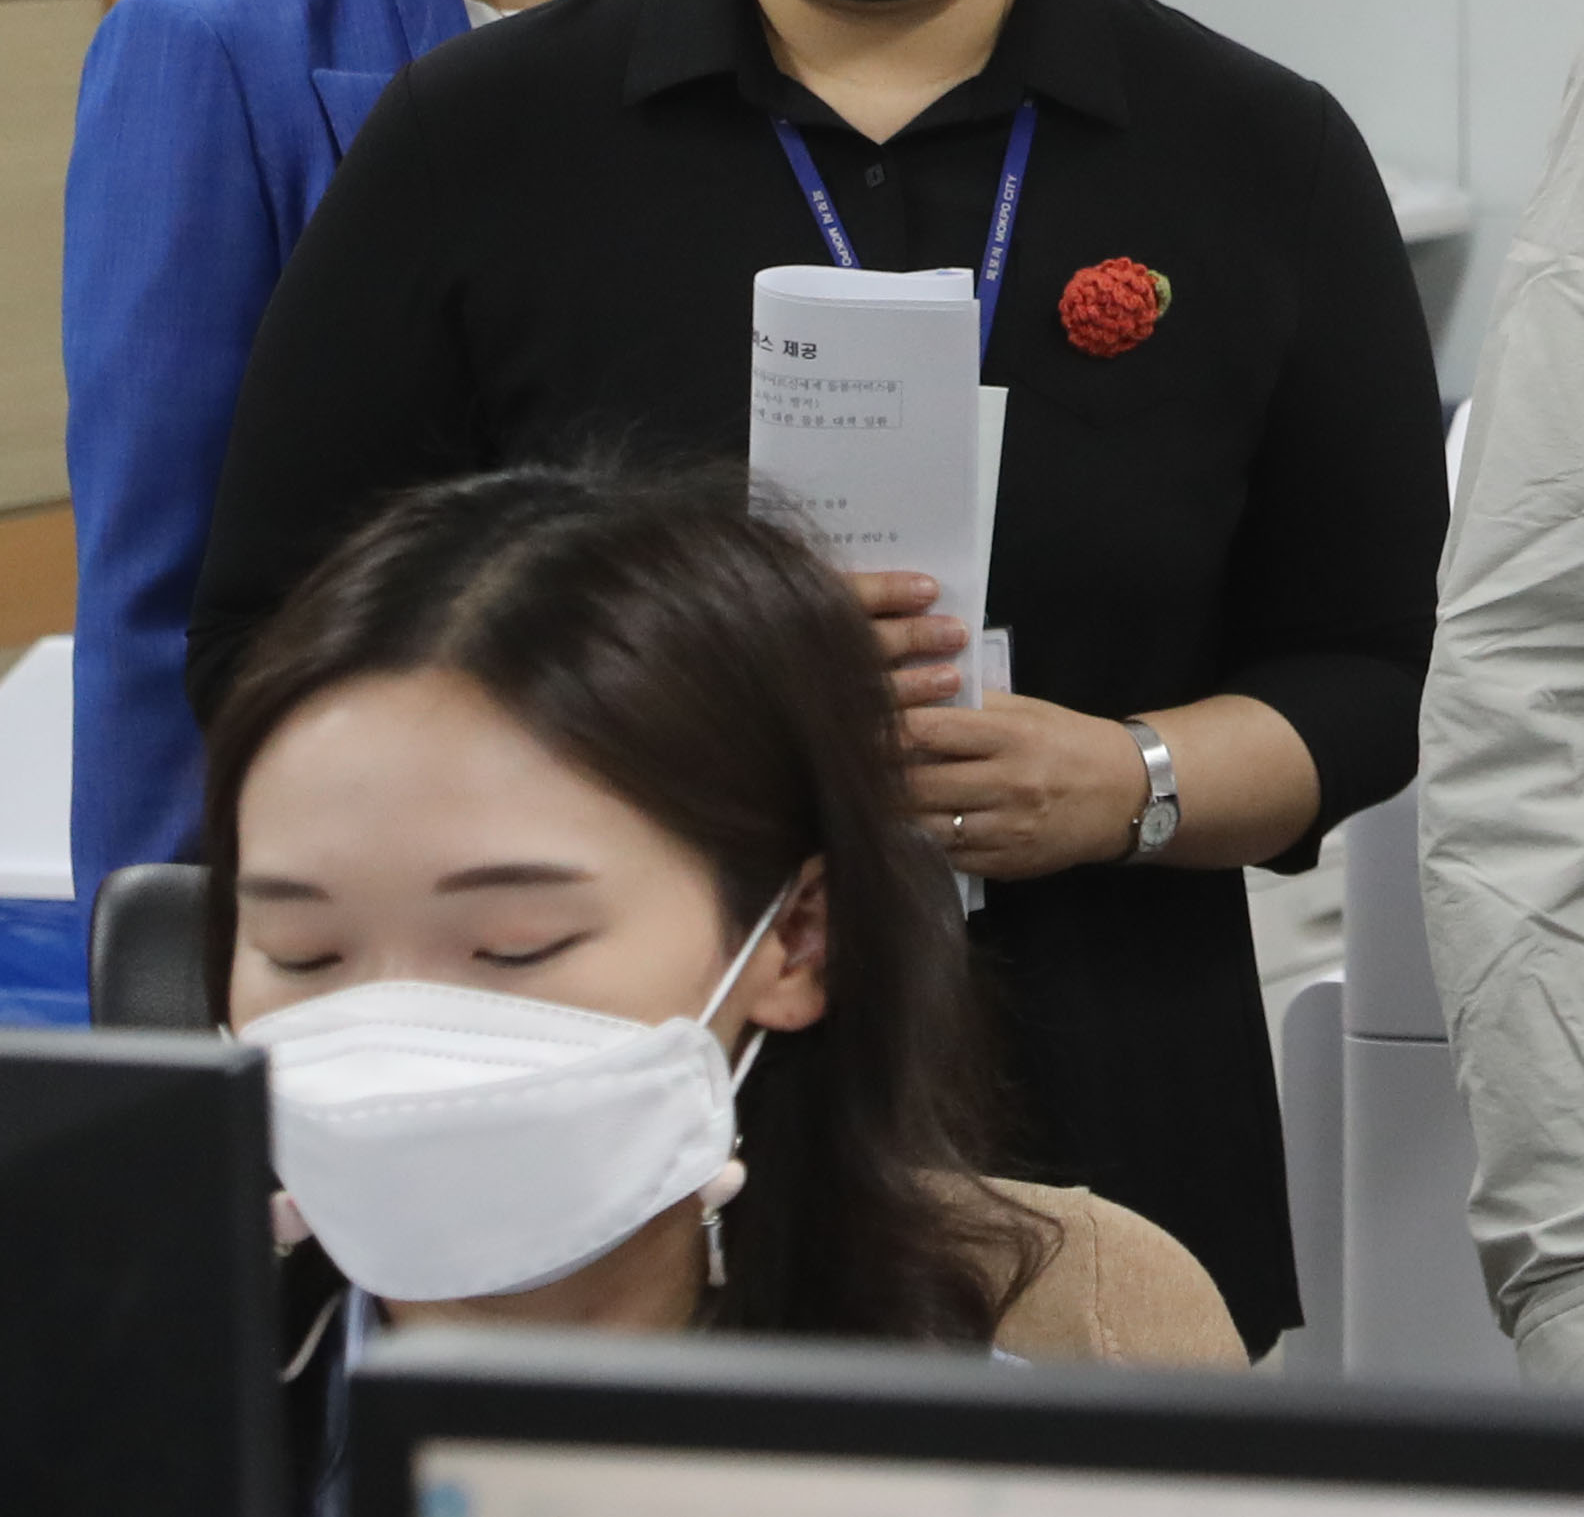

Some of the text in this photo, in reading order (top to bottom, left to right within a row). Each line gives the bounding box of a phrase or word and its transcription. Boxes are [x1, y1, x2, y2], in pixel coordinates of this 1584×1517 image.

[812, 190, 853, 267] 목포시 MOKPO
[985, 174, 1018, 281] 목포시 MOKPO CITY
[783, 340, 817, 359] 제공
